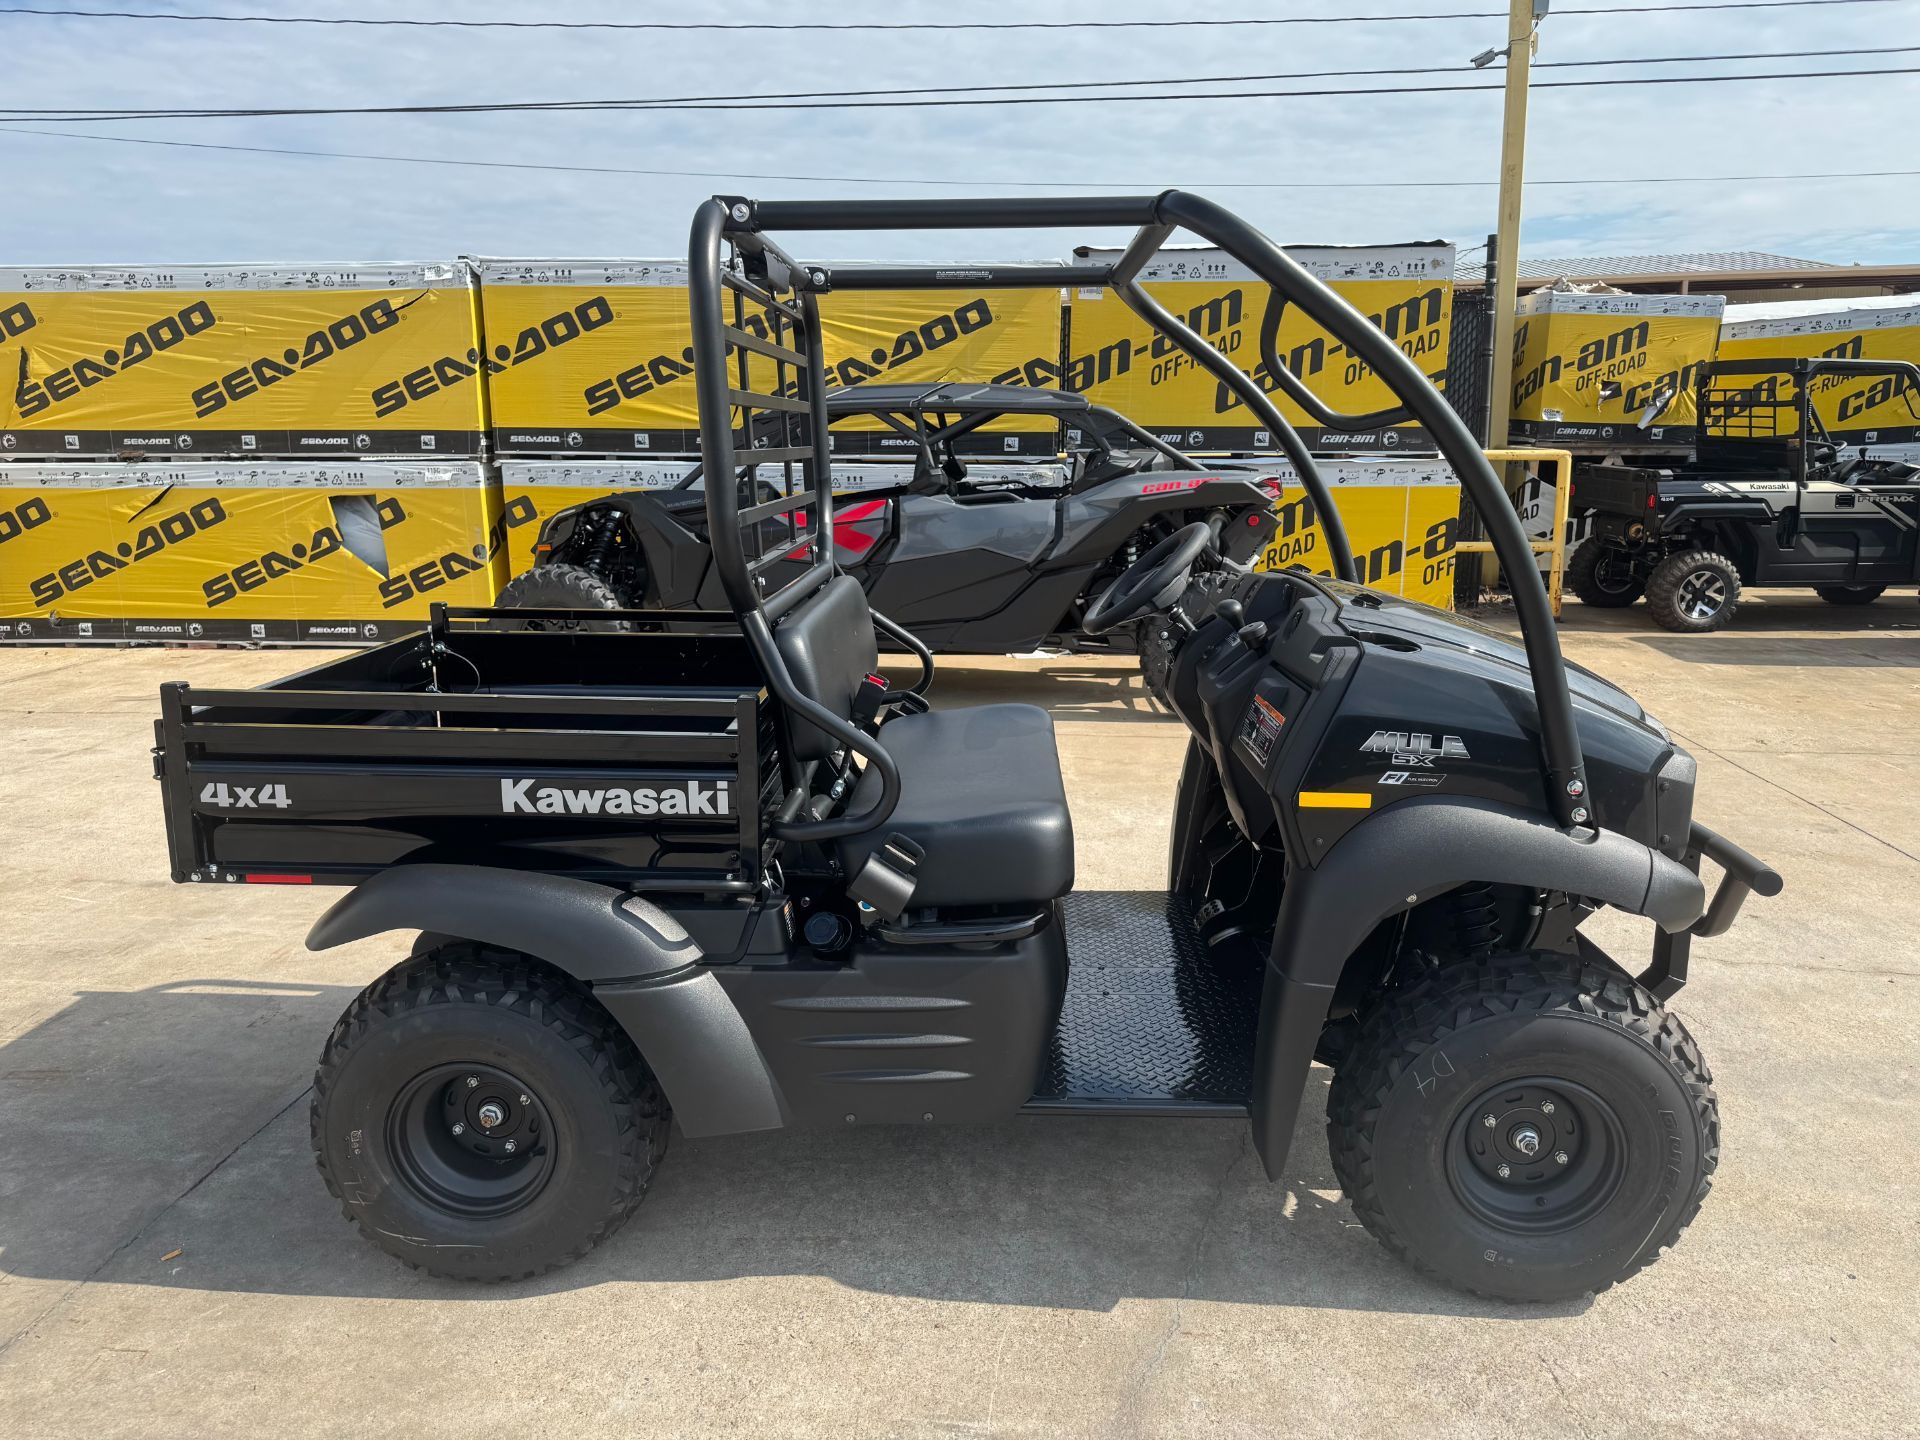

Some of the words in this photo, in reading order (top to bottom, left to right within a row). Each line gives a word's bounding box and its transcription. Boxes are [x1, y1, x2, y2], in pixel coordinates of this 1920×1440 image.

[1513, 321, 1649, 410] can-am
[1575, 352, 1647, 392] OFF-ROAD
[1320, 434, 1376, 444] can-am
[1557, 427, 1598, 436] can-am
[1857, 494, 1916, 503] PRO-MX
[1359, 730, 1471, 759] MULE
[1391, 753, 1435, 767] SX
[200, 783, 292, 808] 4x4
[500, 778, 729, 815] Kawasaki
